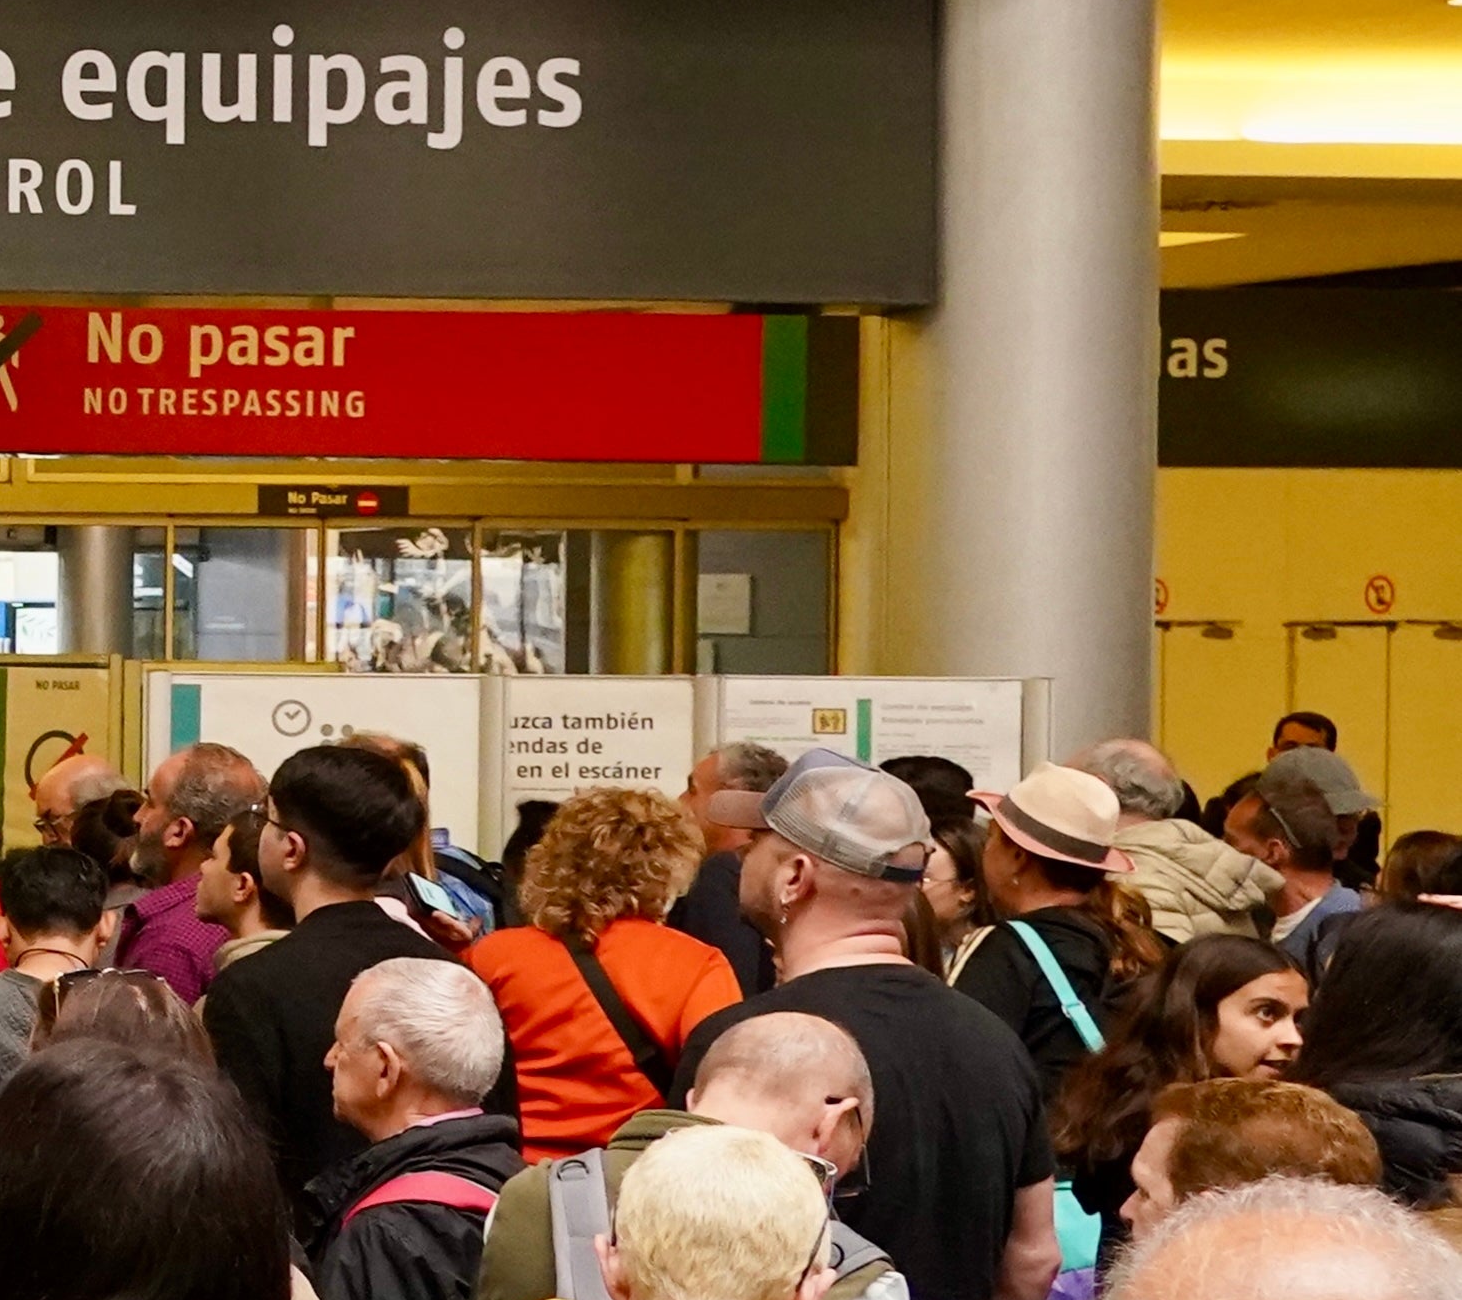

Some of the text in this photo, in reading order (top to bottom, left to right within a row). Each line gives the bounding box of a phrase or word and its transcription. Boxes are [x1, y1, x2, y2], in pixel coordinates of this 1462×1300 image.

[61, 26, 582, 150] equipajes
[87, 311, 356, 378] No pasar
[1161, 337, 1229, 379] as
[84, 386, 365, 419] NO TRESPASSING
[287, 491, 348, 506] No Pasar
[35, 678, 81, 692] NO PASAR
[562, 712, 653, 730] también
[576, 738, 603, 754] de
[517, 761, 662, 779] en el escáner
